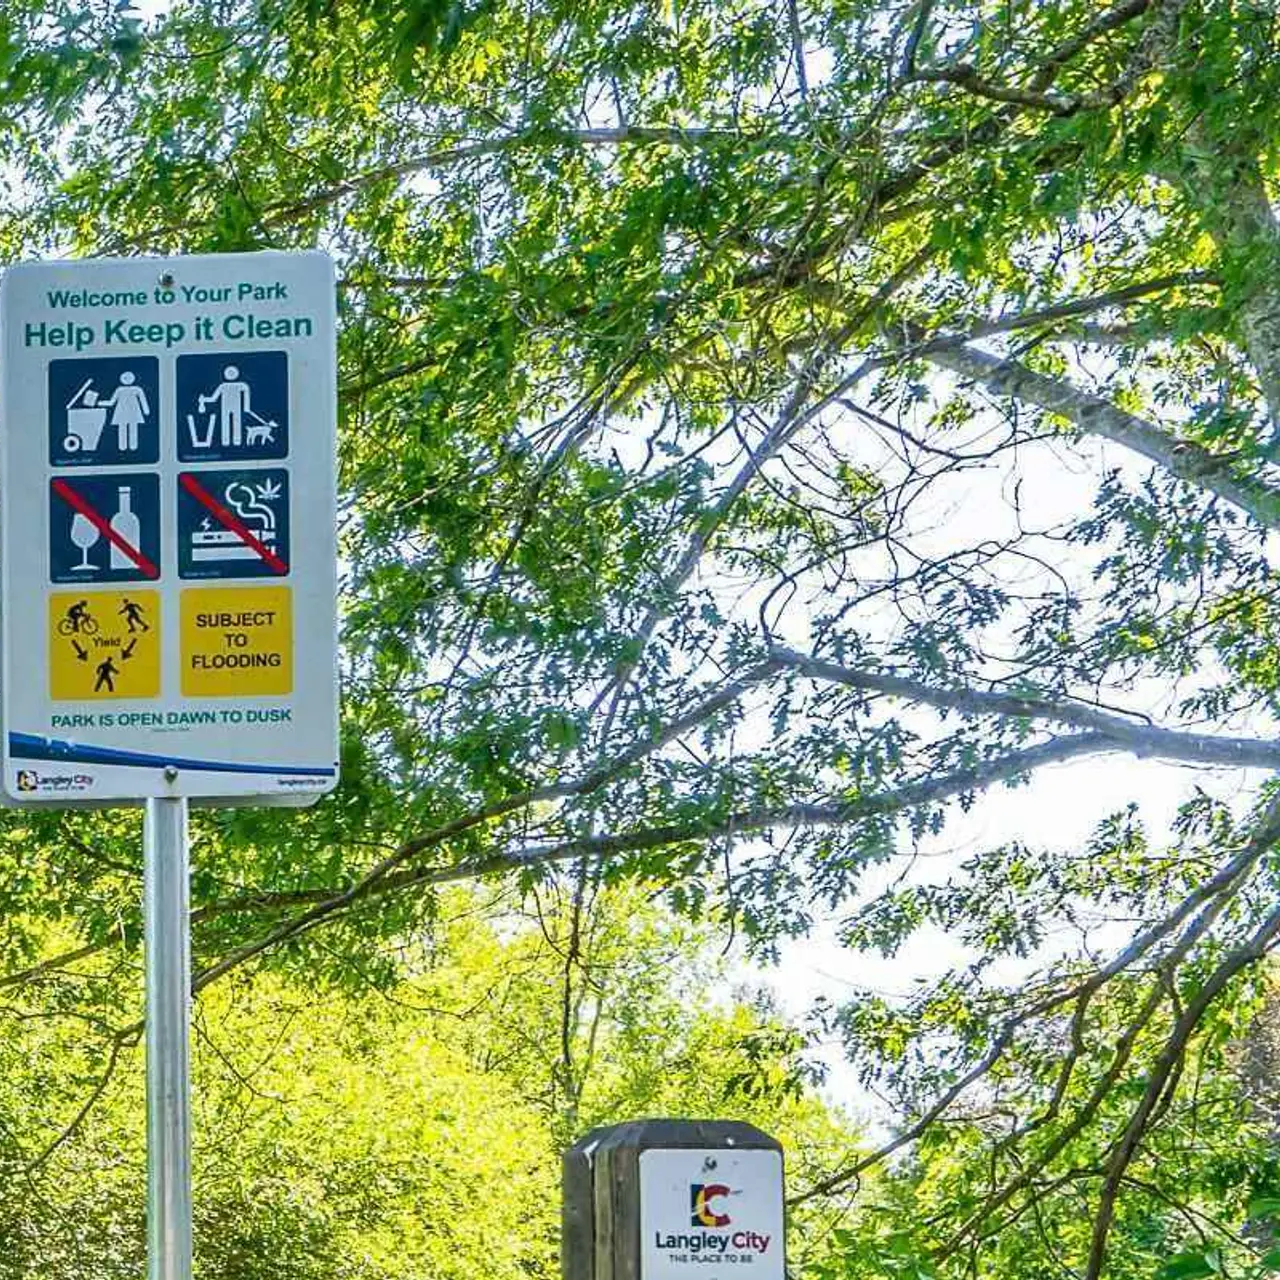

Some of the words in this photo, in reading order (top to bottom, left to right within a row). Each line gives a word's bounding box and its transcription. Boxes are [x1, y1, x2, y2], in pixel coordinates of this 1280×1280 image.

[47, 289, 148, 310] Welcome
[154, 286, 176, 305] to
[181, 285, 231, 304] Your
[238, 282, 288, 301] Park
[25, 322, 95, 351] Help
[105, 319, 186, 347] Keep
[195, 316, 213, 341] it
[223, 314, 313, 340] Clean
[195, 612, 276, 628] SUBJECT
[92, 636, 122, 649] Yield
[224, 633, 248, 649] TO
[191, 653, 282, 670] FLOODING
[51, 714, 95, 728] PARK
[99, 714, 114, 727] IS
[118, 712, 163, 727] OPEN
[167, 711, 216, 725] DAWN
[221, 709, 242, 723] TO
[246, 708, 292, 723] DUSK
[655, 1231, 730, 1253] Langley
[732, 1230, 771, 1254] City
[669, 1254, 689, 1263] THE
[691, 1254, 722, 1263] PLACE
[725, 1254, 739, 1263] TO
